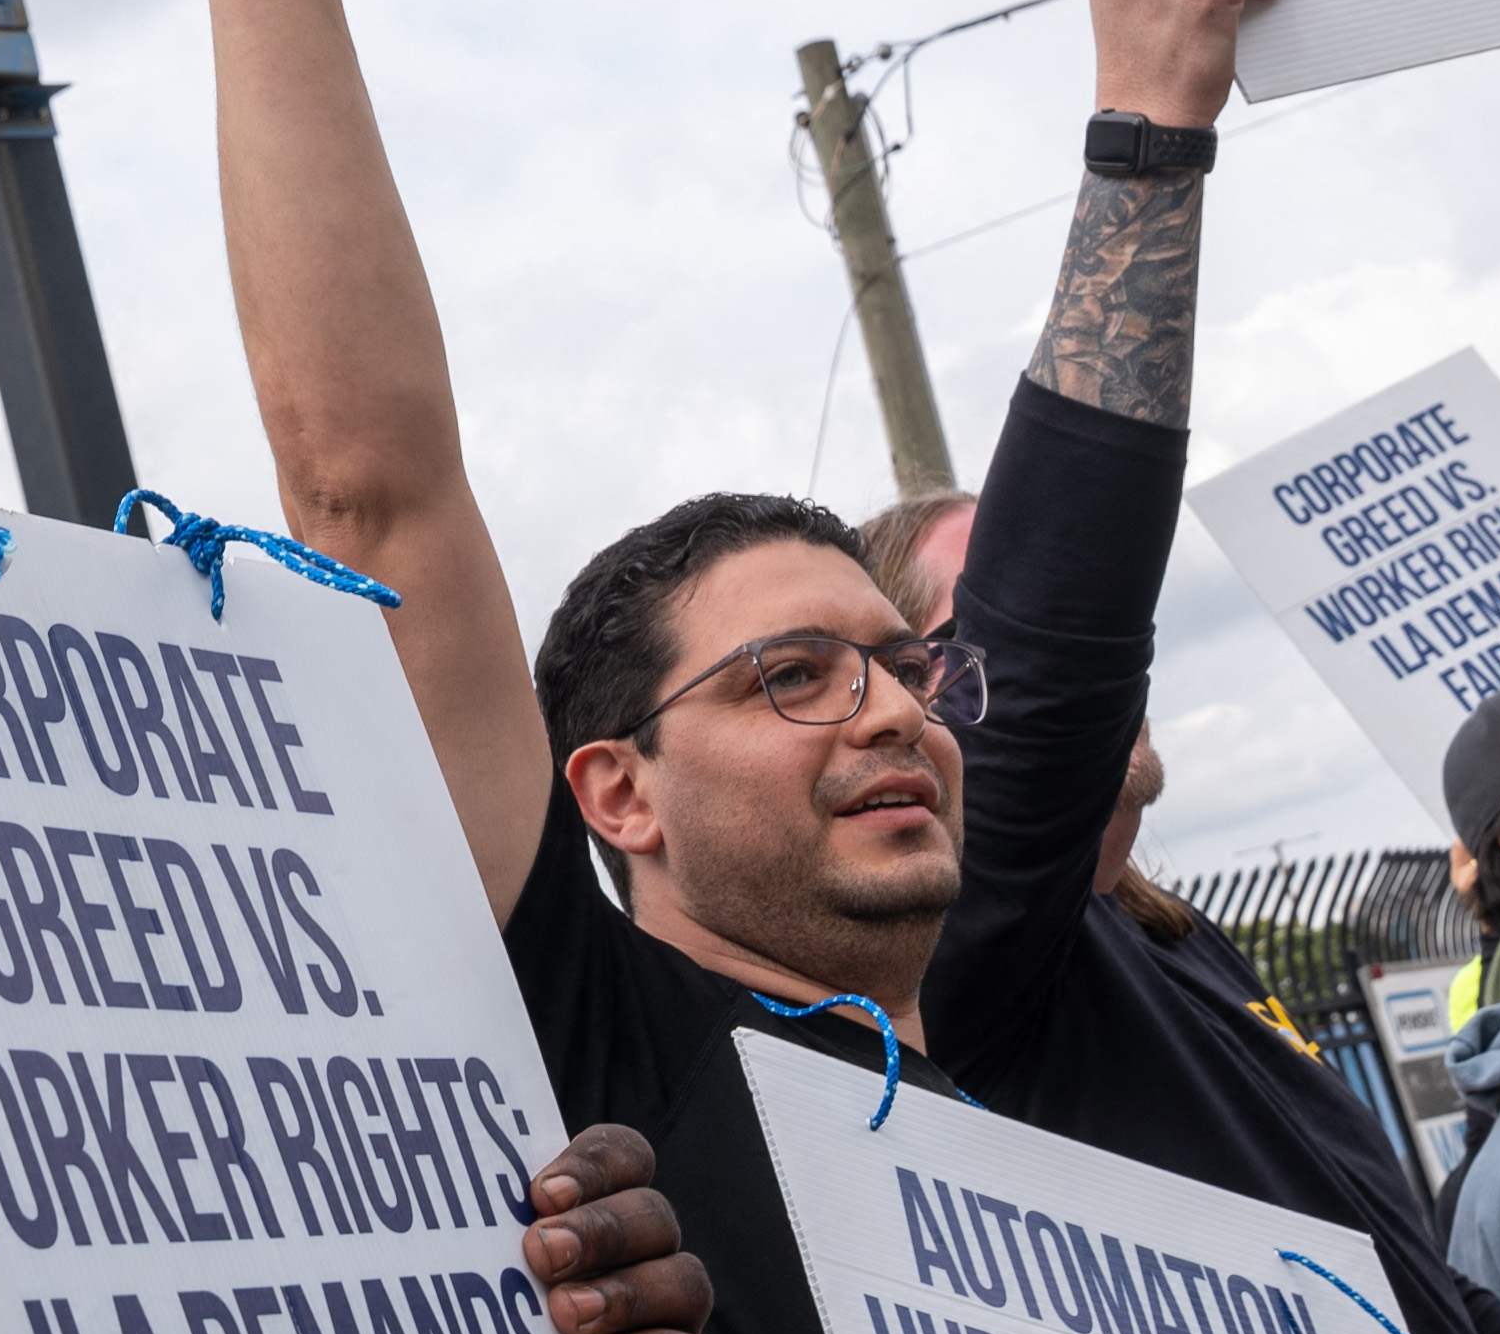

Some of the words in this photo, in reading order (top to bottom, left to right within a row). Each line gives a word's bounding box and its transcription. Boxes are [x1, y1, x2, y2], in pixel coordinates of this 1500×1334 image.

[1273, 402, 1470, 526] CORPORATE
[1321, 484, 1439, 568] GREED
[1425, 460, 1497, 514] VS.
[1304, 543, 1462, 644] WORKER
[1370, 619, 1445, 681] ILA
[228, 848, 383, 1018] VS.
[268, 1048, 540, 1237] RIGHTS:
